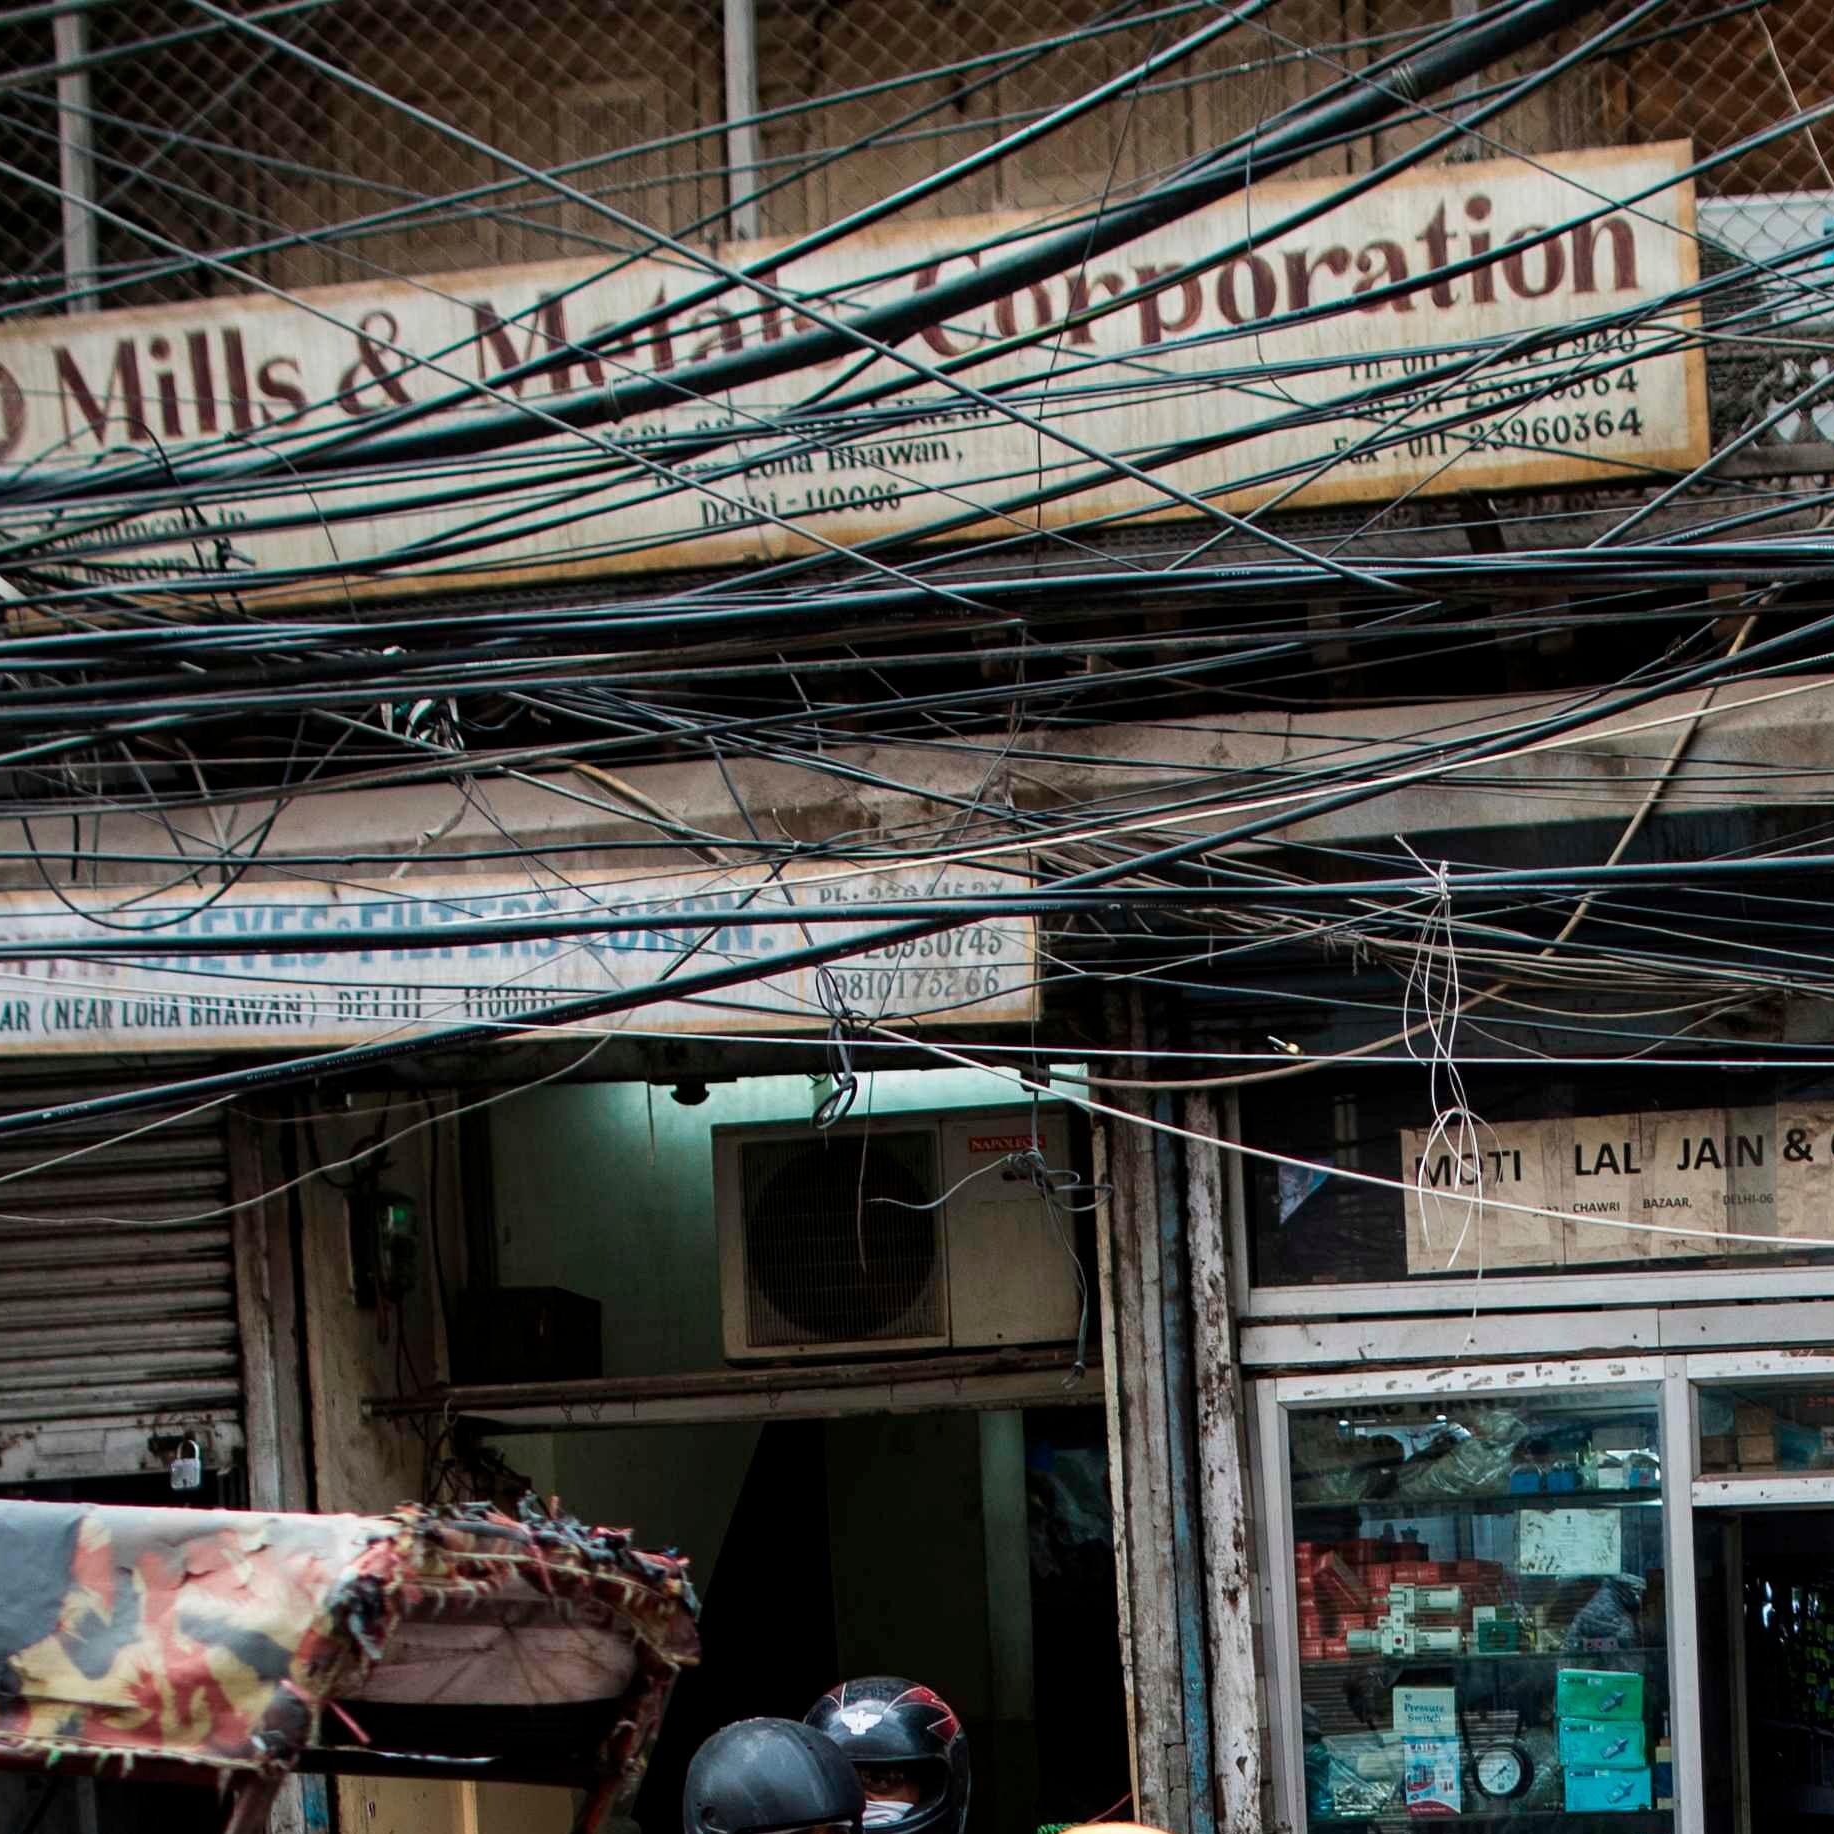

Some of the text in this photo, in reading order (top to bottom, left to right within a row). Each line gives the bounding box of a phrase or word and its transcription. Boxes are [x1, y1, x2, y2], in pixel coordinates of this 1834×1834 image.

[52, 327, 308, 445] Mills
[338, 310, 413, 417] &
[1469, 407, 1643, 453] 23960364
[121, 997, 182, 1031] LOHA
[337, 986, 423, 1022] DELHI
[1414, 1150, 1523, 1188] MOTI
[1573, 1141, 1643, 1177] LAL
[1676, 1134, 1765, 1171] JAIN
[1782, 1127, 1813, 1163] &
[1572, 1201, 1621, 1214] CHAWRI
[1642, 1195, 1693, 1210] BAZAAR,
[1721, 1192, 1774, 1206] DELHI-06
[1403, 1702, 1446, 1715] Pressure
[1406, 1711, 1444, 1724] Switch
